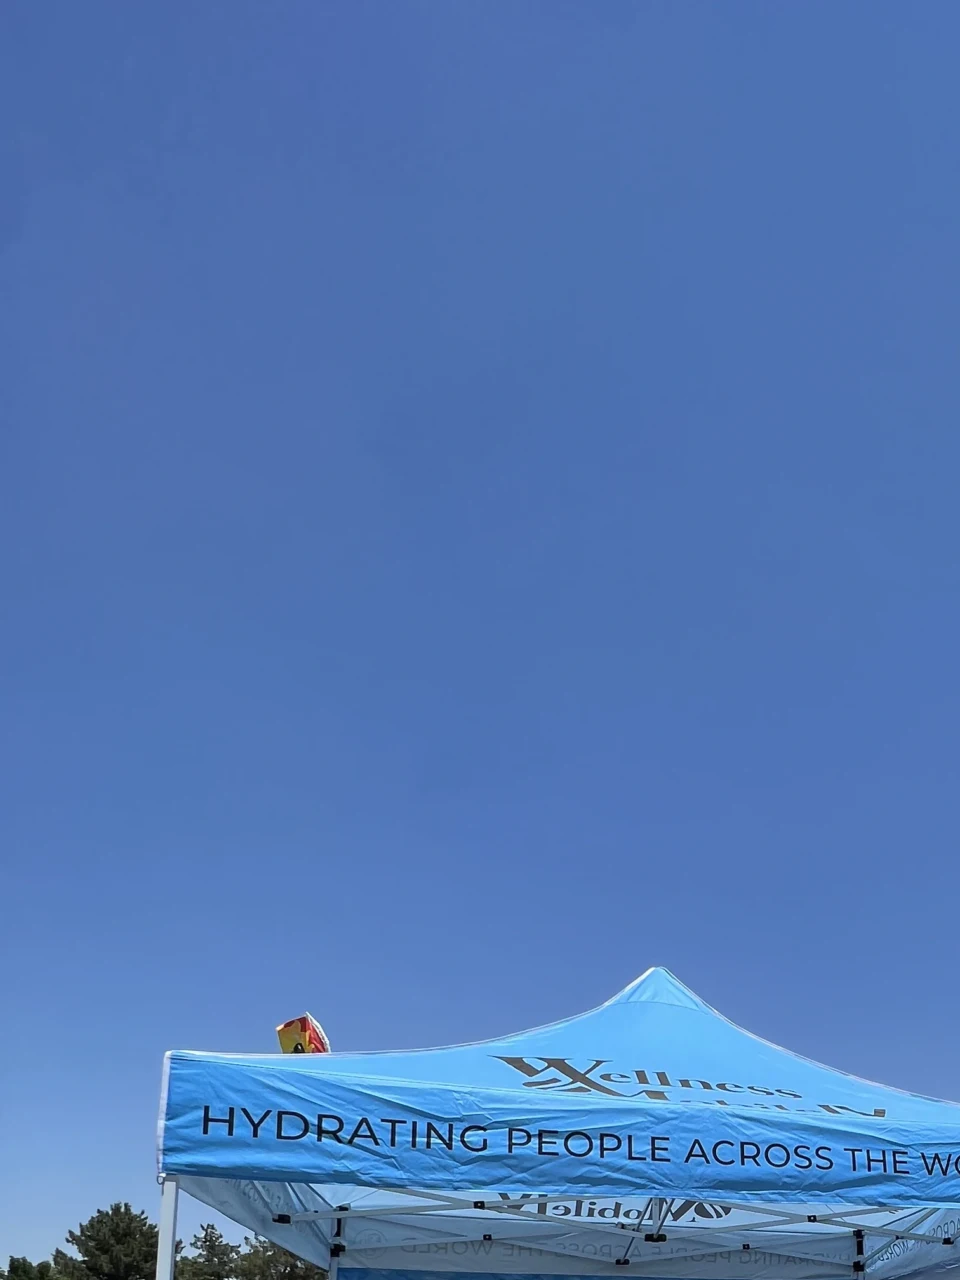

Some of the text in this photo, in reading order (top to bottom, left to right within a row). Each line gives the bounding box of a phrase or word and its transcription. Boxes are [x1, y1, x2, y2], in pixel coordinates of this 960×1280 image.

[487, 1055, 803, 1099] Wellness
[202, 1105, 488, 1153] HYDRATING
[508, 1127, 671, 1162] PEOPLE
[684, 1138, 834, 1171] ACROSS
[845, 1148, 910, 1175] THE
